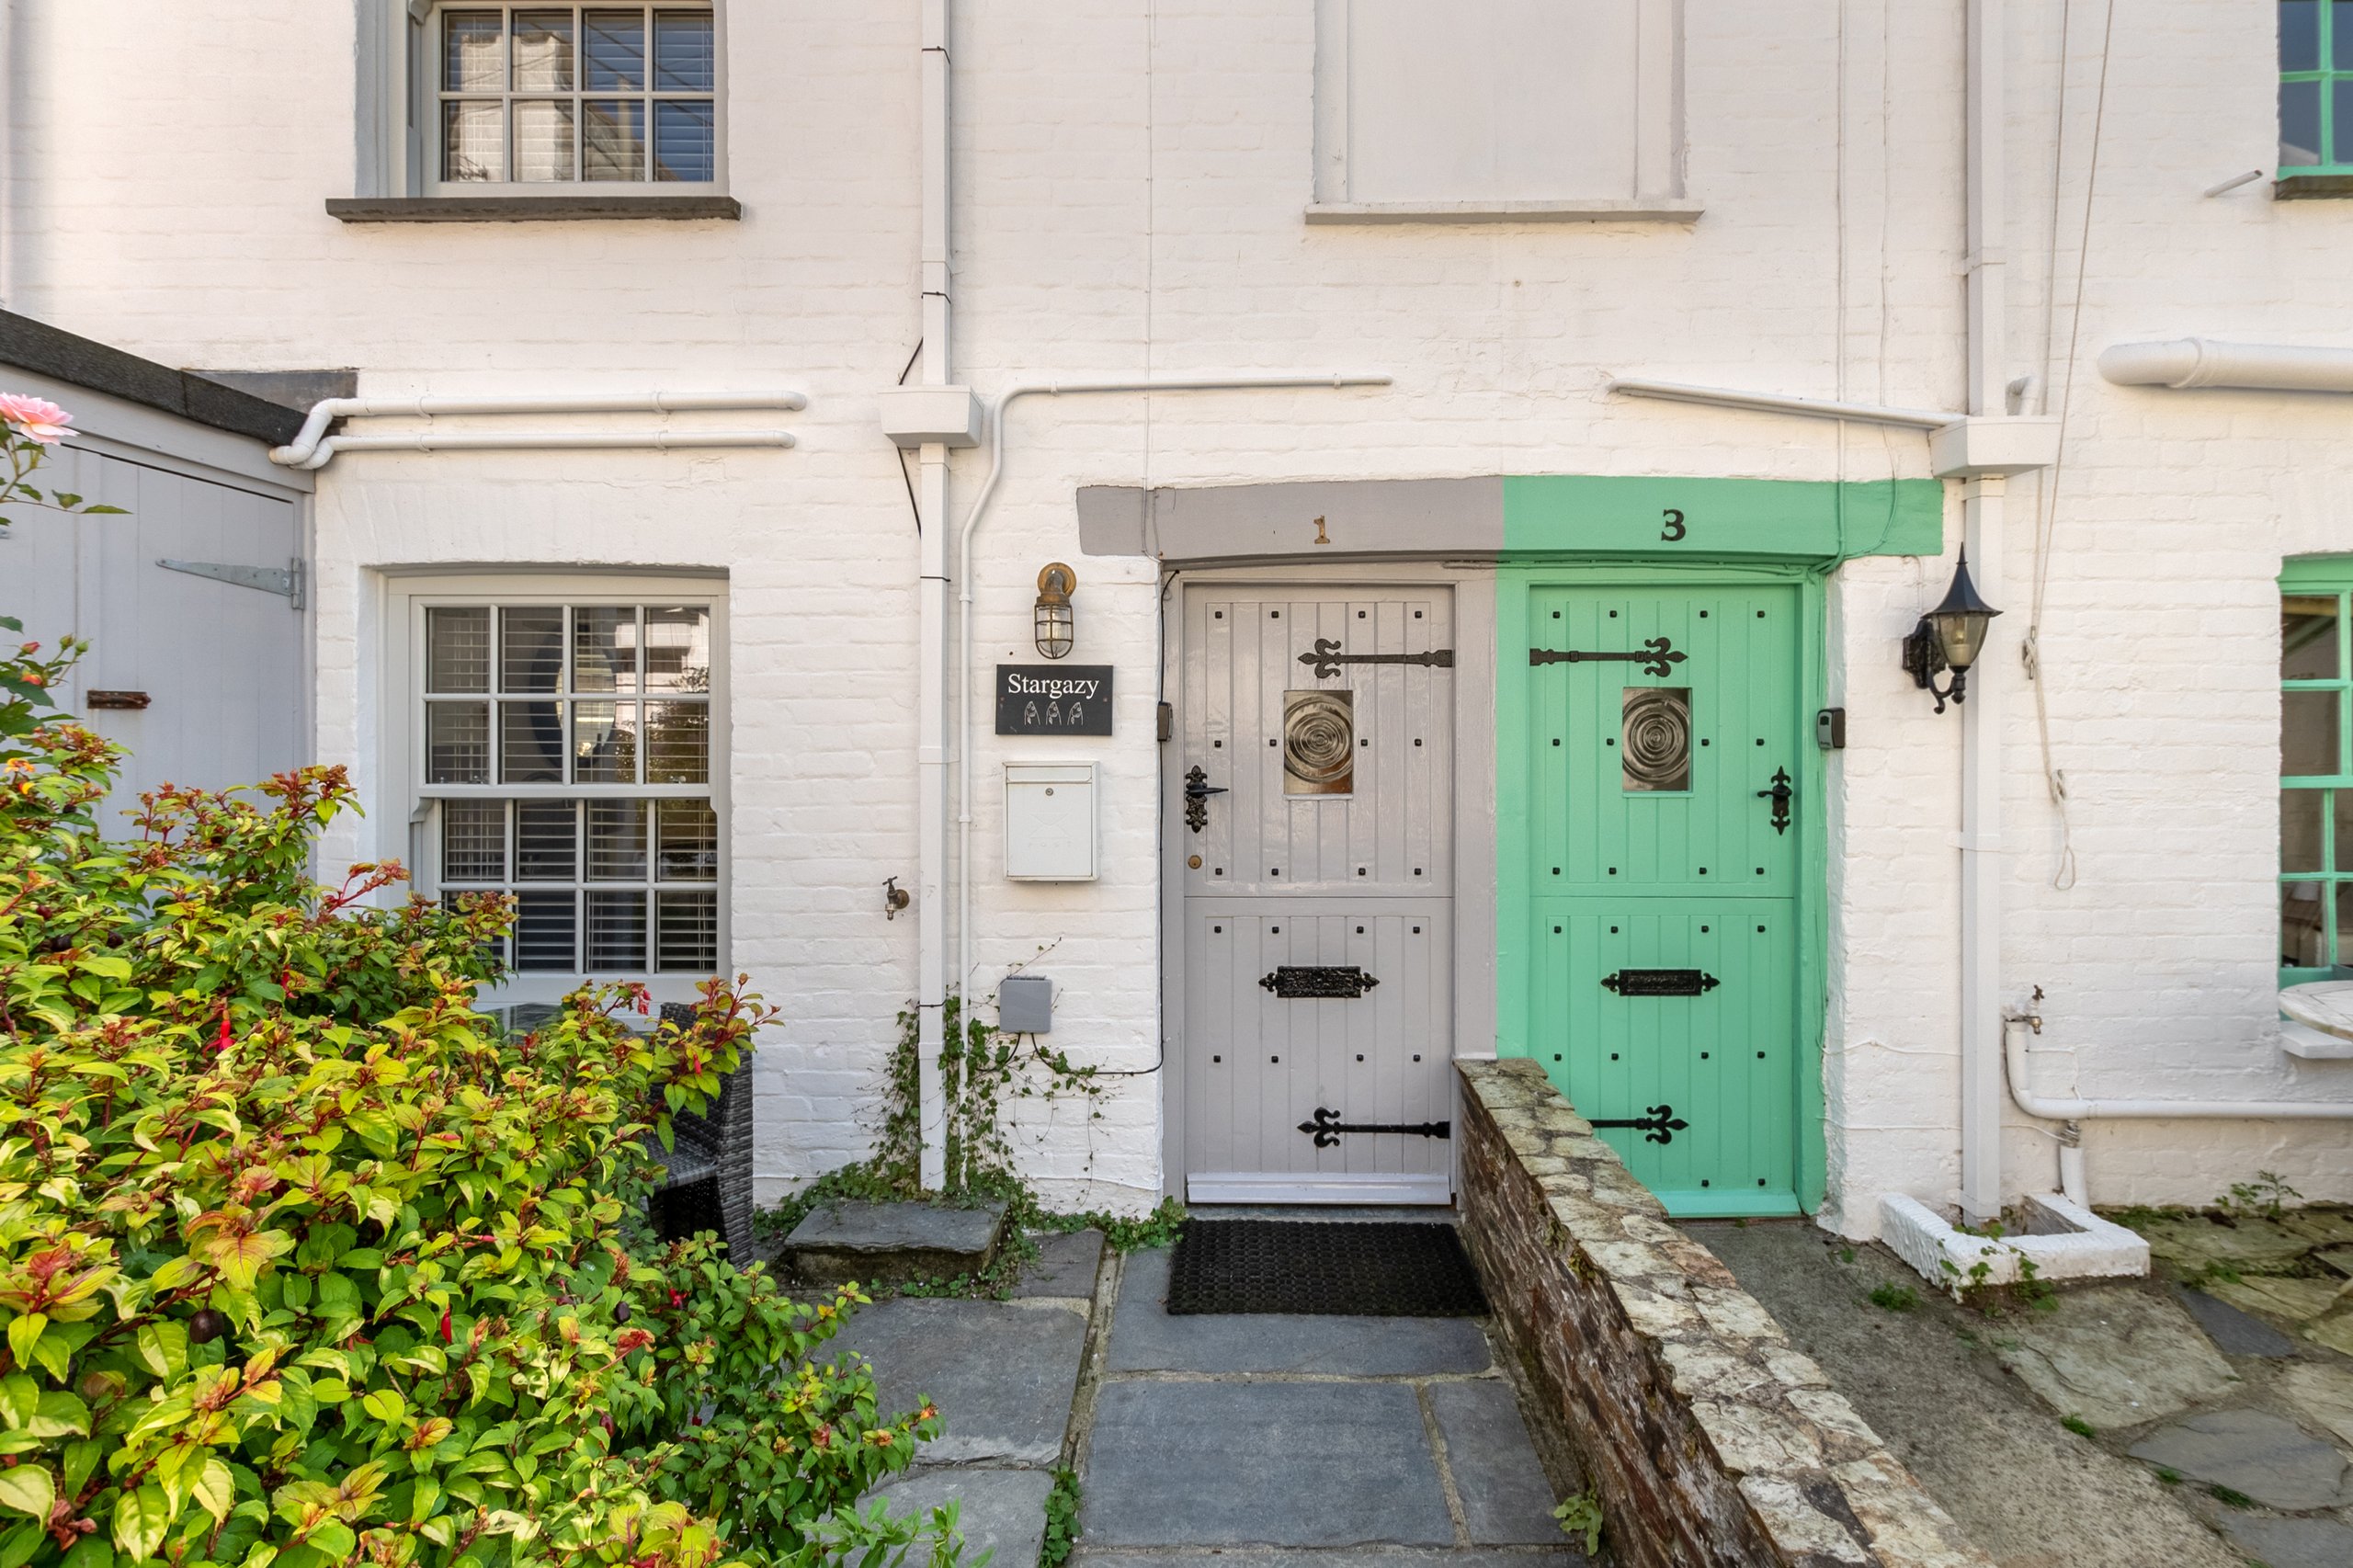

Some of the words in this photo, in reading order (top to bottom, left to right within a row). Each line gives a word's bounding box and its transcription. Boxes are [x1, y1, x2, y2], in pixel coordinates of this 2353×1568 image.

[1313, 515, 1330, 544] 1
[1661, 508, 1686, 541] 3
[1007, 673, 1100, 699] Stargazy
